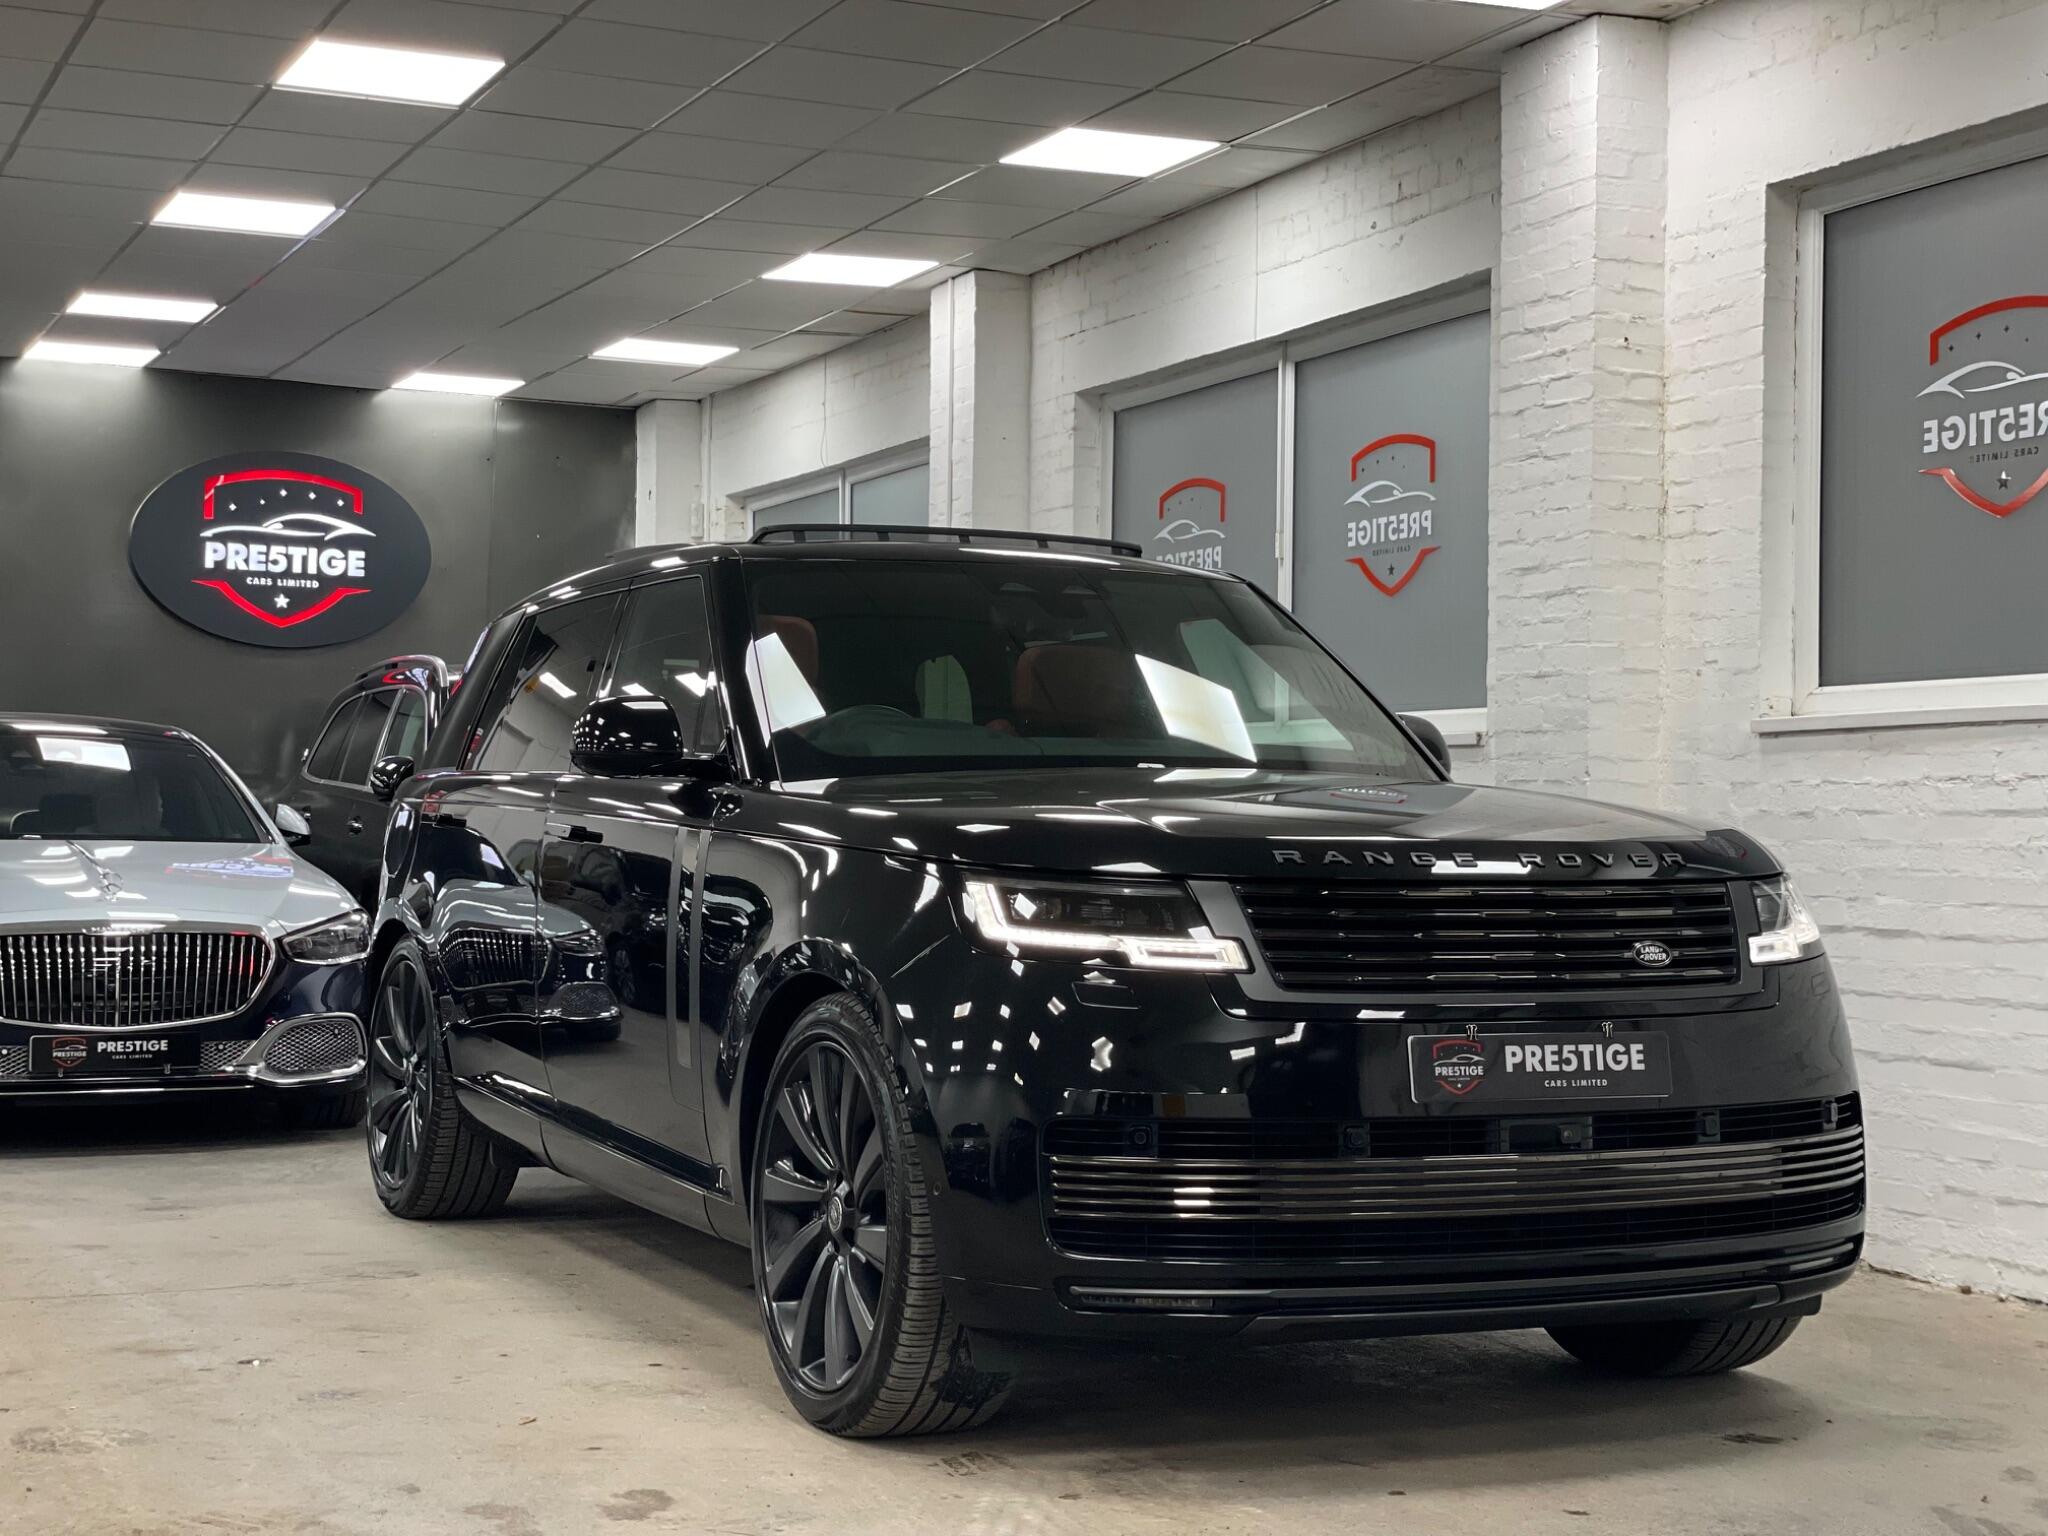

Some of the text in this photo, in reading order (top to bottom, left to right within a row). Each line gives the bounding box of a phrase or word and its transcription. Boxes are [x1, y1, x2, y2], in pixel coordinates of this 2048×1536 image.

[204, 541, 366, 577] PRE5TIGE
[277, 578, 320, 589] LIMITED
[1272, 849, 1687, 868] RANGE ROVER
[1640, 945, 1660, 954] LAND
[1644, 952, 1667, 961] ROVER
[1504, 1043, 1646, 1073] PRE5TIGE
[1571, 1079, 1608, 1087] LIMITED
